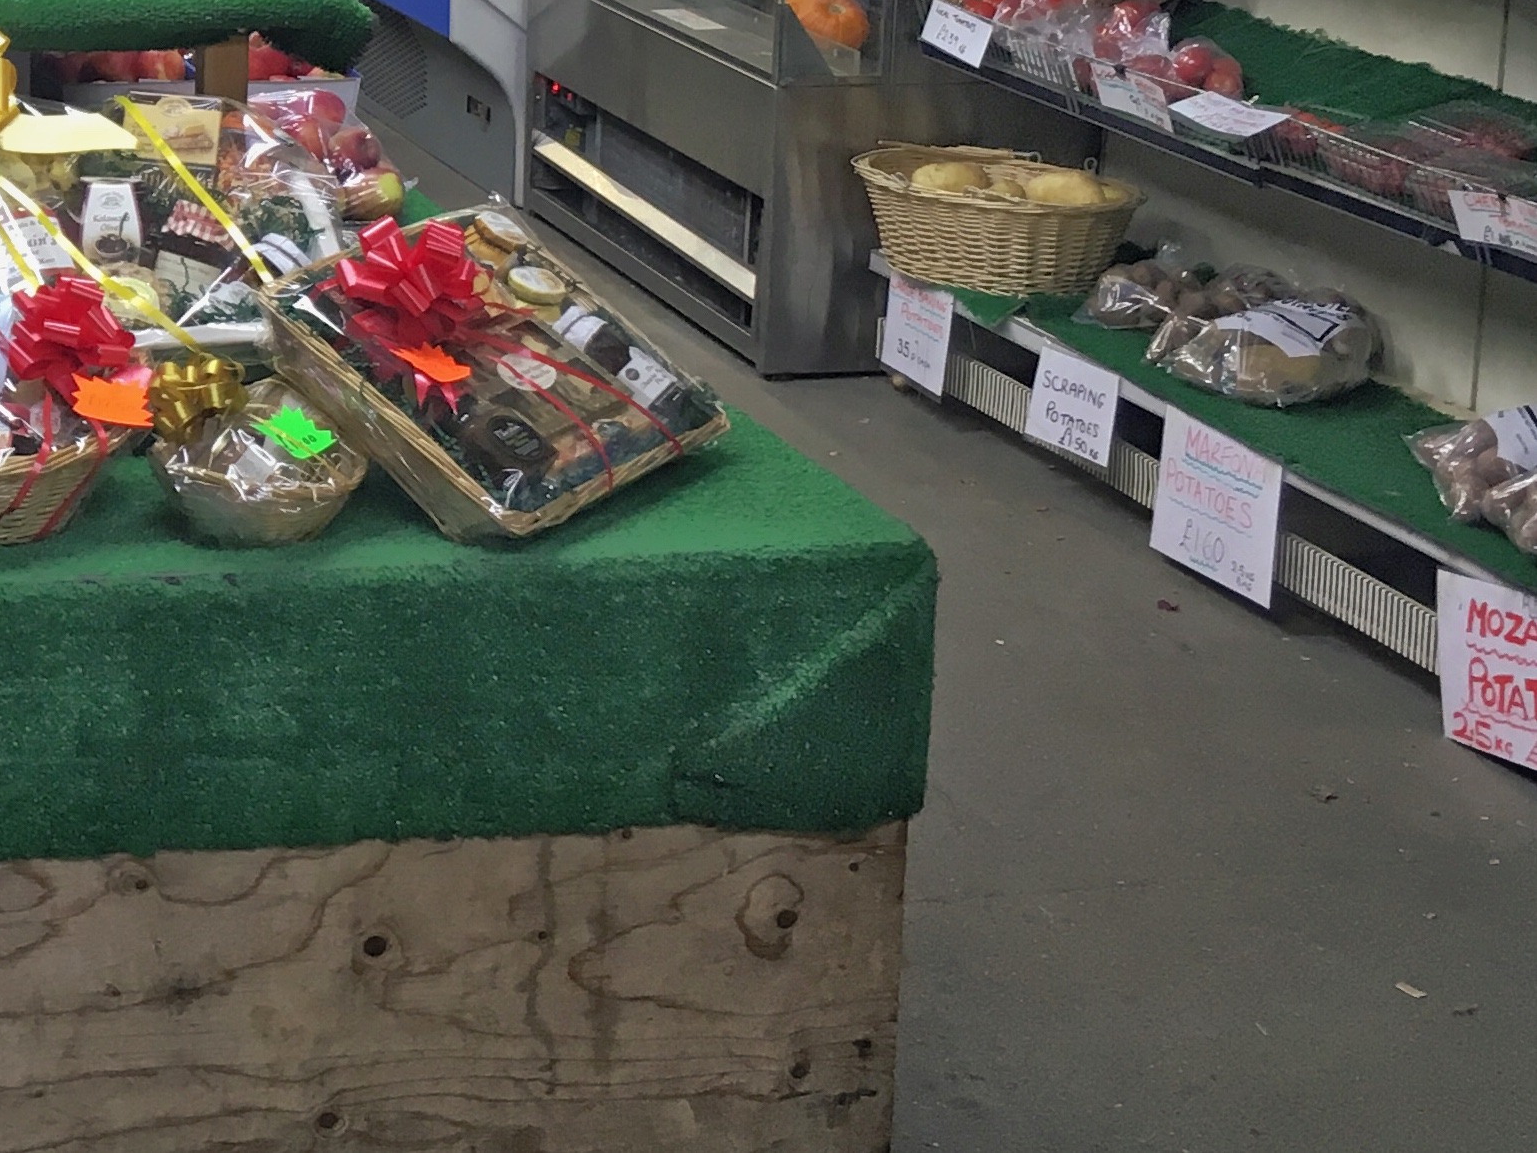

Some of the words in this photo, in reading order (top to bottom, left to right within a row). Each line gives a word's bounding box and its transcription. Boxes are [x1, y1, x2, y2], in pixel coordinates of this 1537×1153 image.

[1042, 369, 1107, 409] SCRAPING
[1045, 400, 1100, 438] POTATOES
[1185, 425, 1266, 484] MARFONA
[1165, 456, 1253, 530] POTATOES
